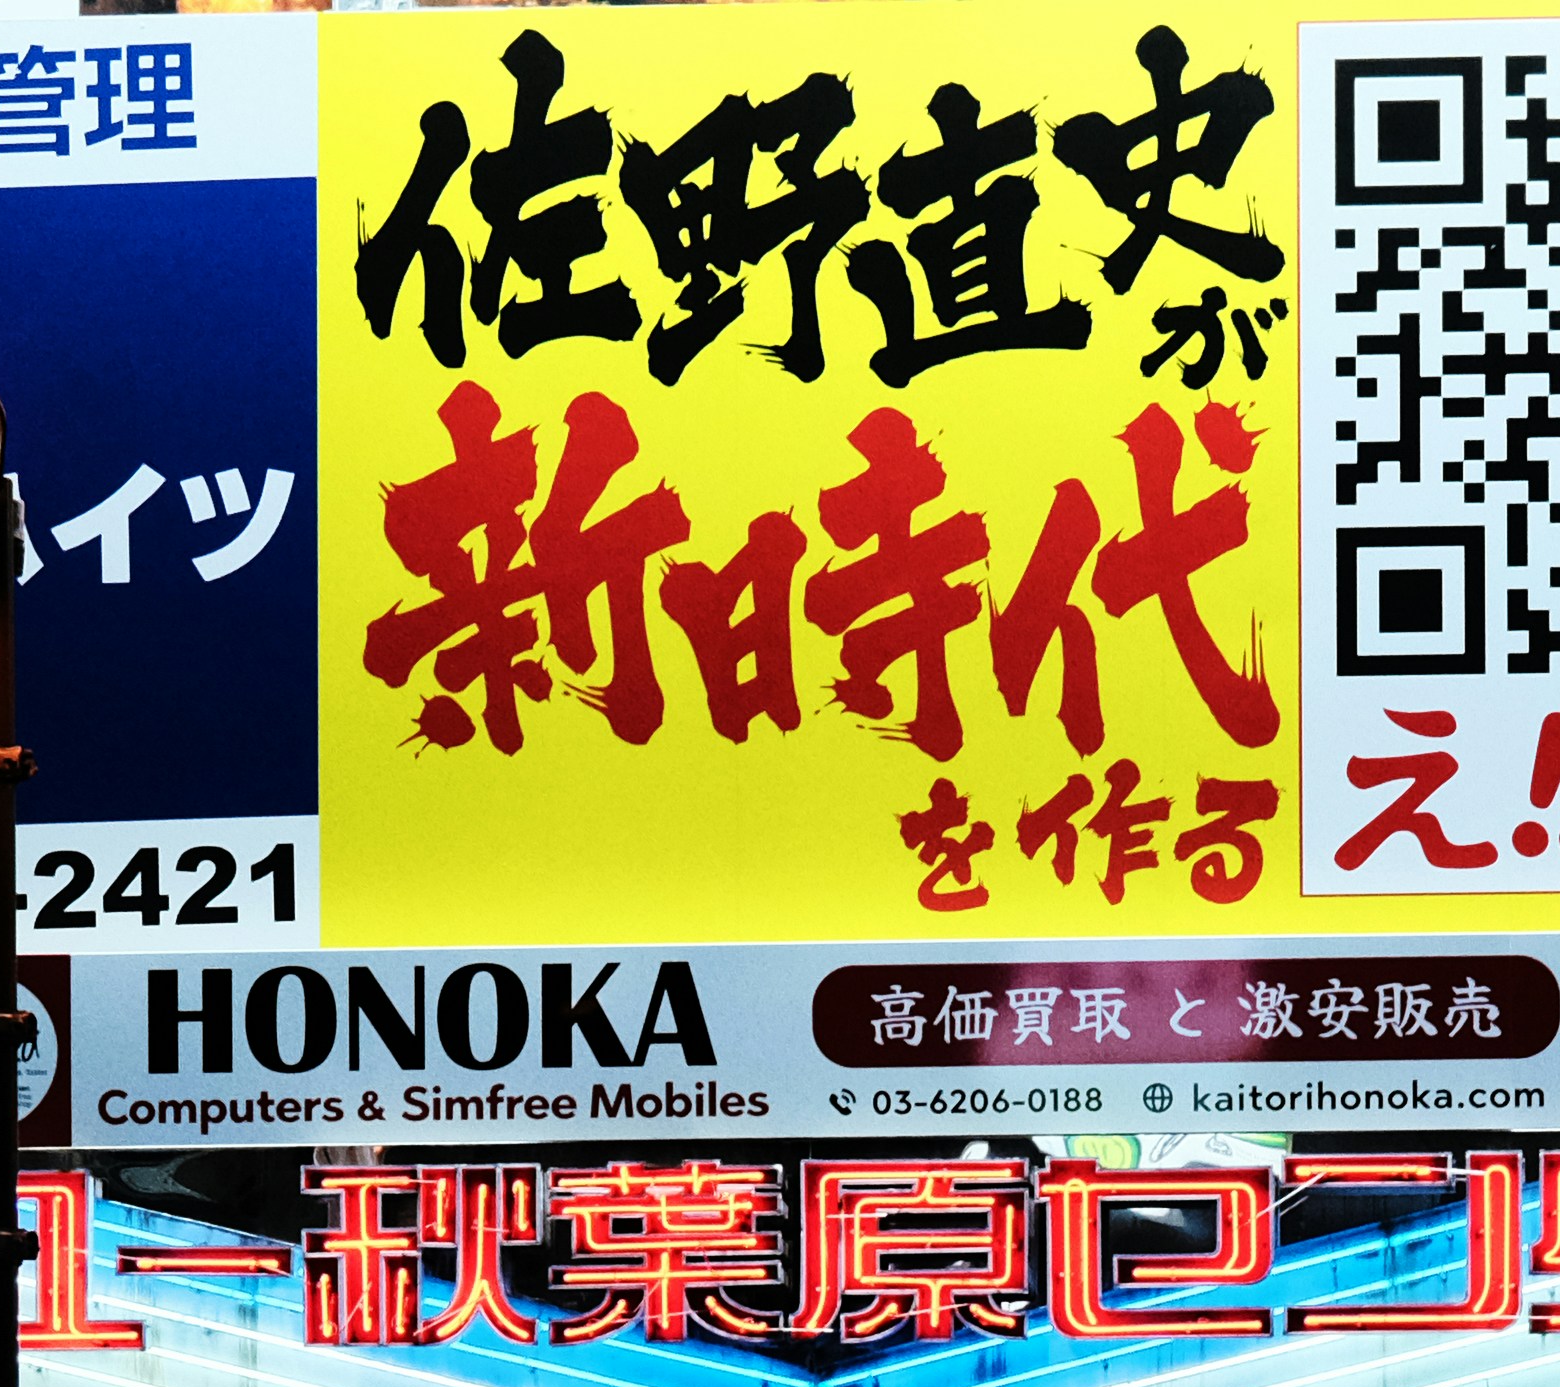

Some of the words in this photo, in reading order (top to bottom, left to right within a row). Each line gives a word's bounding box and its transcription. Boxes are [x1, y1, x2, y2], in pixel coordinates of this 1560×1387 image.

[357, 24, 1289, 389] 佐野直史が
[363, 378, 1282, 762] 新時代
[898, 755, 1287, 911] を作る
[145, 960, 719, 1075] HONOKA
[868, 984, 1132, 1048] 高価買取
[1167, 985, 1208, 1038] と
[1236, 973, 1505, 1044] 激安販売
[96, 1086, 346, 1129] Computers
[356, 1090, 388, 1122] &
[400, 1081, 579, 1122] Simfree
[587, 1079, 771, 1121] Mobiles
[870, 1083, 1104, 1117] 03-6206-0188
[1190, 1077, 1548, 1116] kaitorihonoka.com
